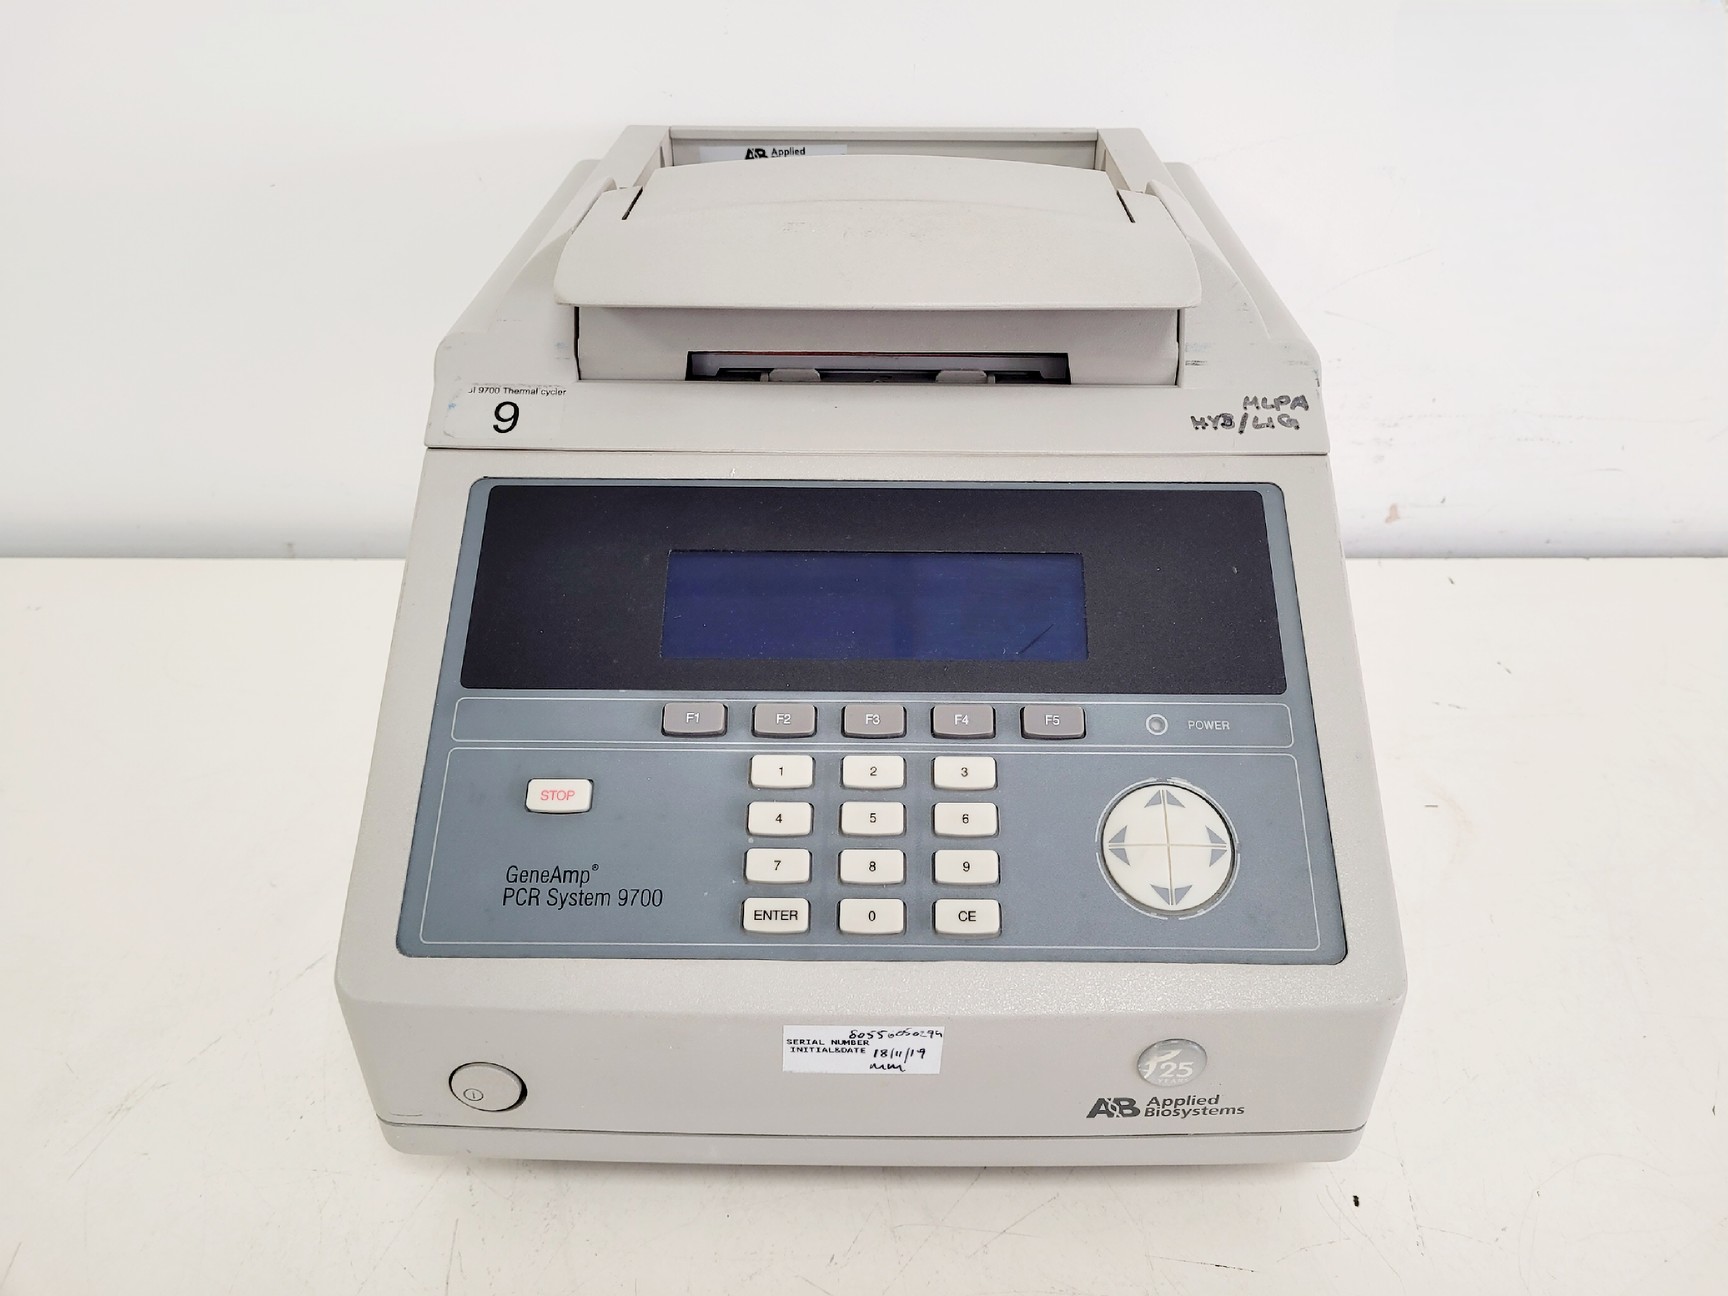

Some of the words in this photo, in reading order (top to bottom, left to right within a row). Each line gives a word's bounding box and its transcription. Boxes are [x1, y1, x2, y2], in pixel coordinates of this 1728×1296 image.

[771, 147, 806, 157] Applied
[503, 387, 539, 395] Thermal
[541, 388, 567, 397] cycler
[1243, 394, 1309, 411] MLPA
[492, 401, 520, 434] 9
[685, 712, 701, 724] F1
[775, 713, 791, 725] F2
[865, 713, 881, 726] F3
[954, 713, 970, 726] F4
[1045, 714, 1061, 726] F5
[1187, 720, 1231, 731] POWER
[778, 767, 785, 776] 1
[870, 767, 877, 776] 2
[961, 767, 969, 777] 3
[540, 790, 576, 801] STOP
[775, 814, 783, 824] 4
[869, 813, 877, 823] 5
[962, 814, 969, 824] 6
[774, 860, 781, 871] 7
[869, 861, 876, 871] 8
[962, 862, 970, 872] 9
[503, 888, 541, 906] PCR
[546, 888, 611, 910] System
[617, 888, 664, 907] 9700
[753, 910, 799, 920] ENTER
[868, 911, 876, 921] 0
[958, 911, 977, 922] CE
[786, 1038, 825, 1046] SERIAL
[790, 1046, 866, 1054] INITIAL&DATE
[873, 1048, 926, 1064] 18/11/19
[1159, 1061, 1195, 1078] 25
[1146, 1094, 1221, 1108] Applied
[1144, 1106, 1246, 1119] Biosystems
